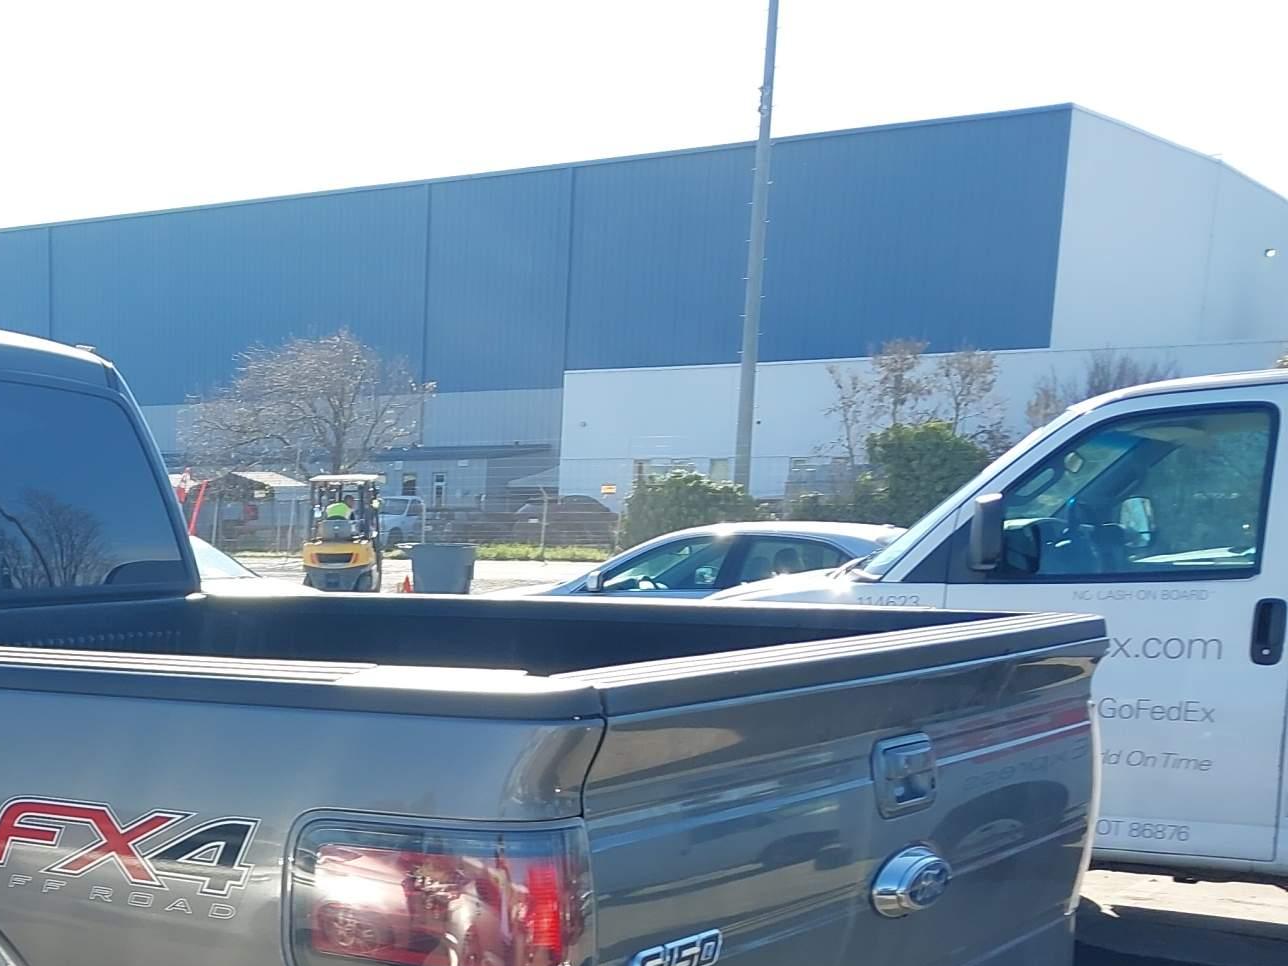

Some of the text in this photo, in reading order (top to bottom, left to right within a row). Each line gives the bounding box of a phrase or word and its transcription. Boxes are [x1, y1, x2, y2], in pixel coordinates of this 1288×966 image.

[1136, 589, 1157, 601] ON
[1161, 589, 1209, 601] BOARD
[1105, 637, 1223, 660] x.com
[1126, 750, 1157, 768] On
[1096, 819, 1126, 836] OT
[88, 886, 237, 920] ROAD
